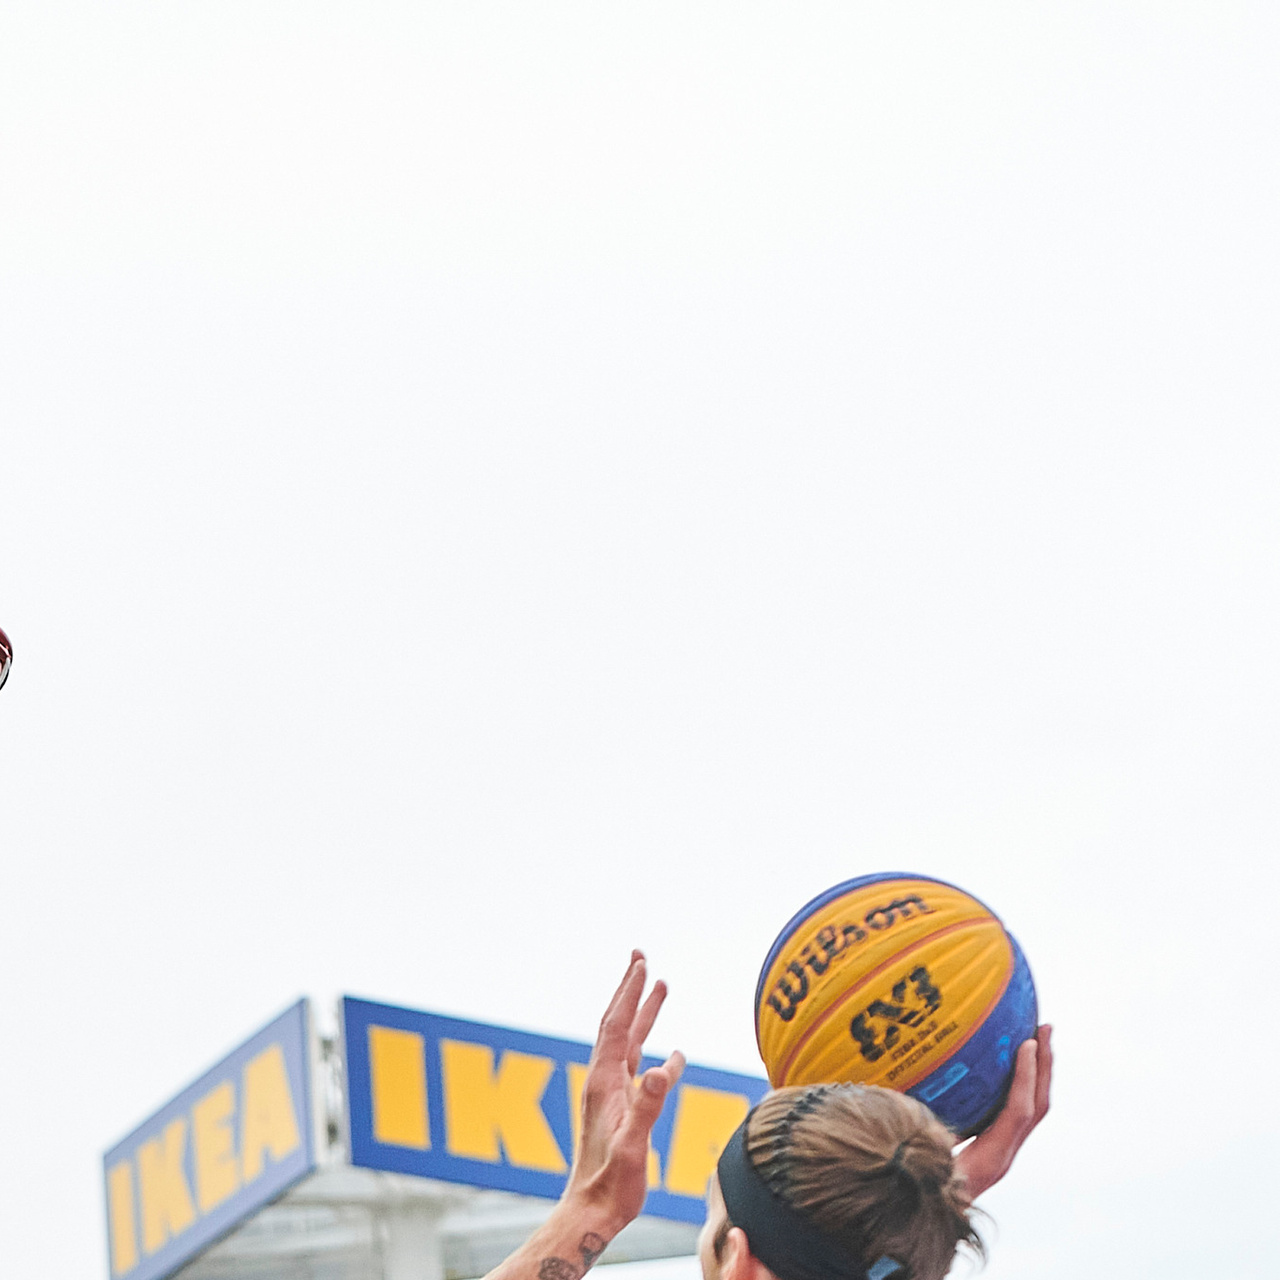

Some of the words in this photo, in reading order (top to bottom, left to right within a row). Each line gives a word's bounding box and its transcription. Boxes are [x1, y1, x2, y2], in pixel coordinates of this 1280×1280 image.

[766, 894, 936, 1022] Wilson
[109, 1043, 302, 1278] IKEA
[368, 1024, 751, 1199] IKA
